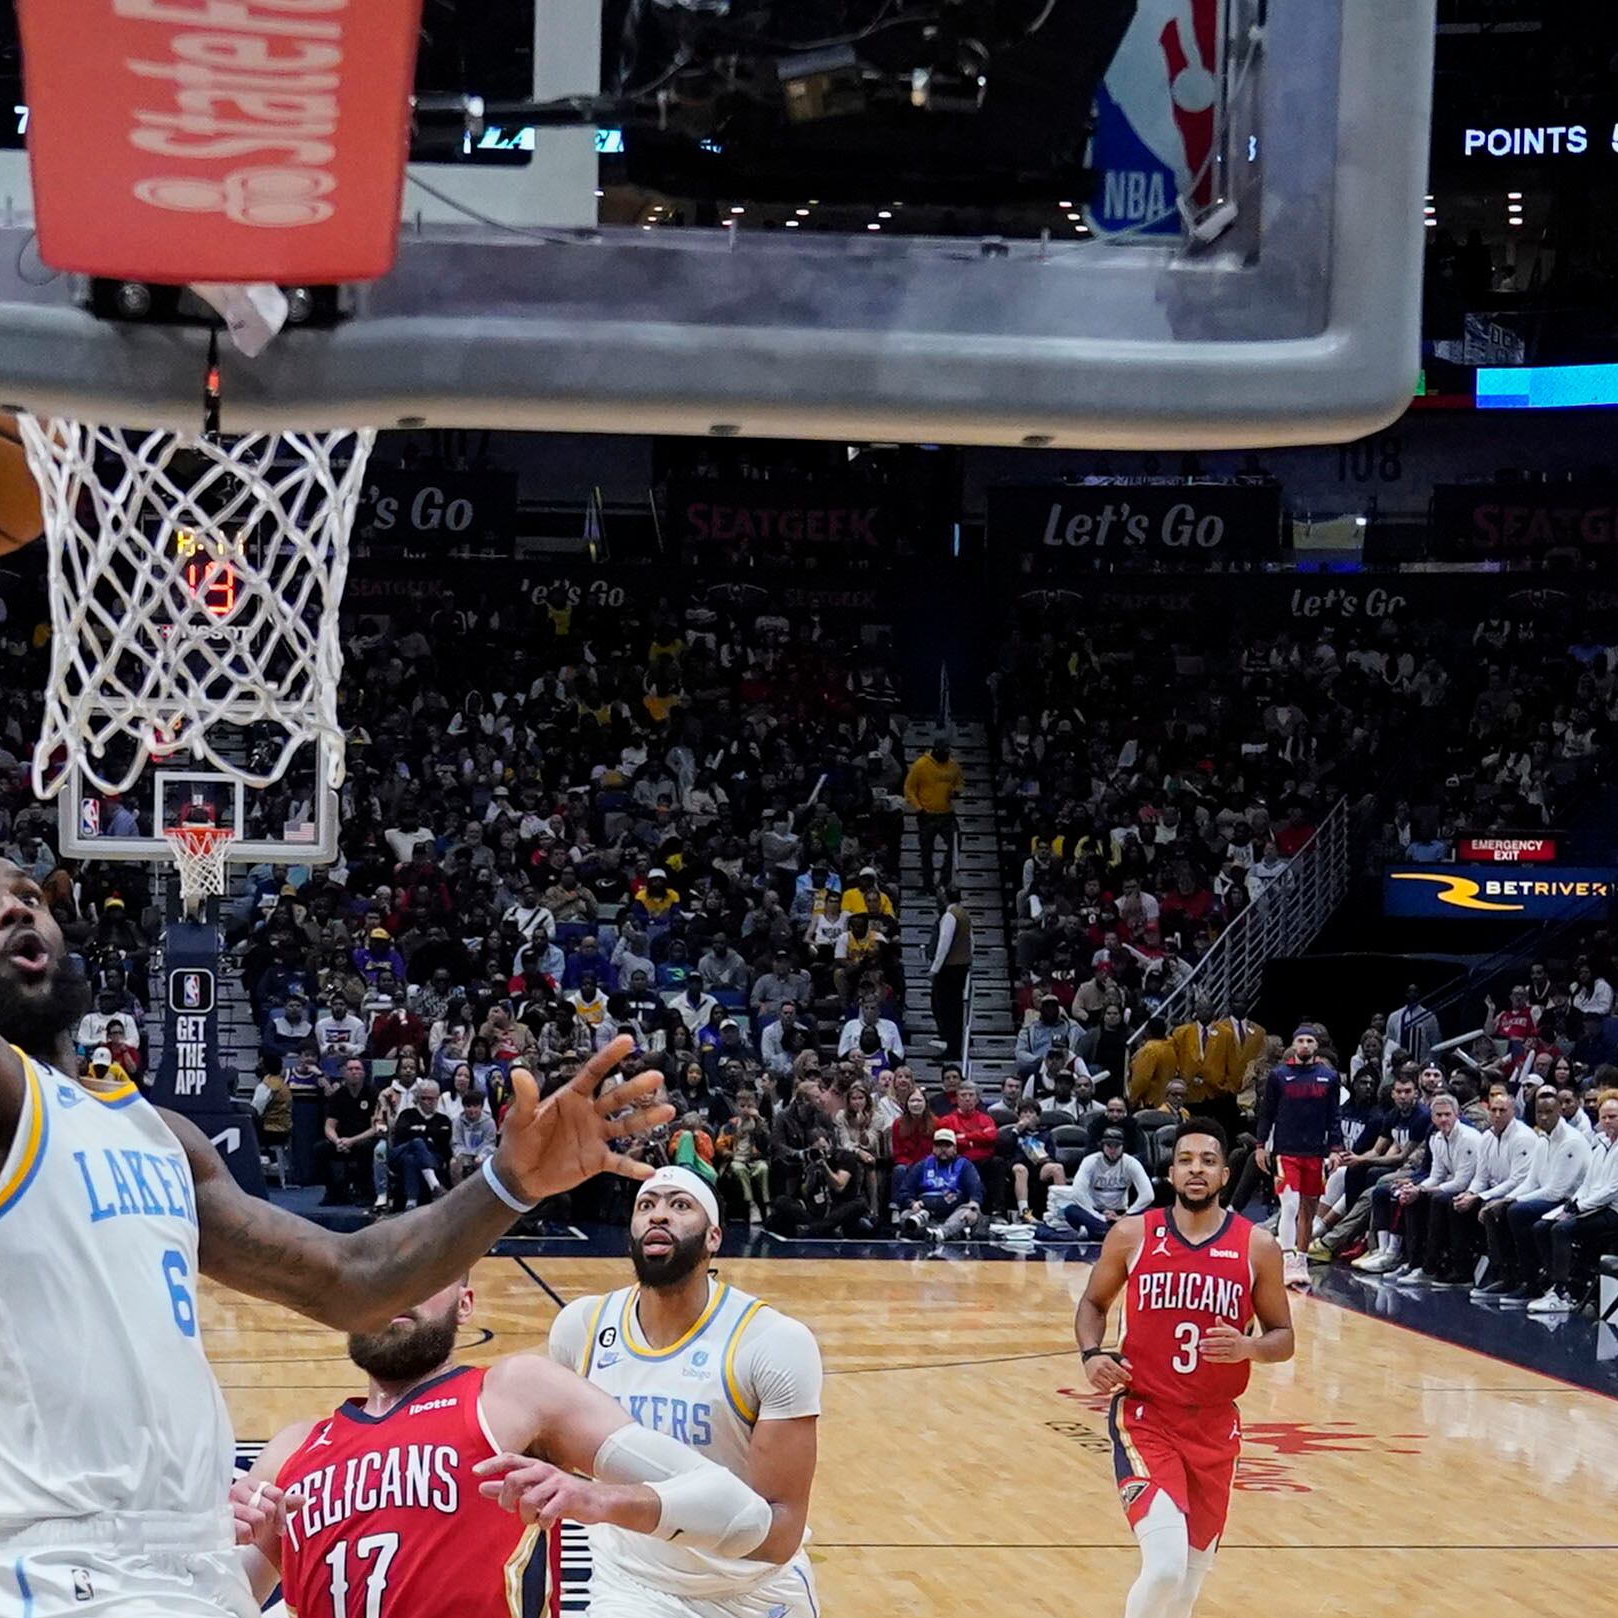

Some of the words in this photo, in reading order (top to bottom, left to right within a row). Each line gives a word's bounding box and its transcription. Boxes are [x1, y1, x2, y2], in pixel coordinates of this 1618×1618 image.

[1465, 126, 1589, 158] POINTS
[1104, 169, 1168, 221] NBA
[1336, 436, 1403, 483] 108
[410, 486, 475, 532] Go
[685, 499, 879, 546] SEATGEEK
[1041, 501, 1151, 548] Let's
[1160, 502, 1225, 549] Go
[1291, 588, 1360, 618] Let's
[1471, 839, 1544, 852] EMERGENCY
[1493, 850, 1520, 861] EXIT
[175, 1016, 207, 1041] GET
[175, 1042, 207, 1068] THE
[174, 1069, 208, 1096] APP
[1209, 1247, 1240, 1260] ibotta
[161, 1250, 196, 1338] 6
[1137, 1273, 1243, 1320] PELICANS
[601, 1328, 617, 1347] 6
[1171, 1321, 1201, 1375] 3
[409, 1396, 458, 1416] ibotta
[614, 1395, 712, 1447] KERS
[284, 1444, 461, 1553] PELICANS
